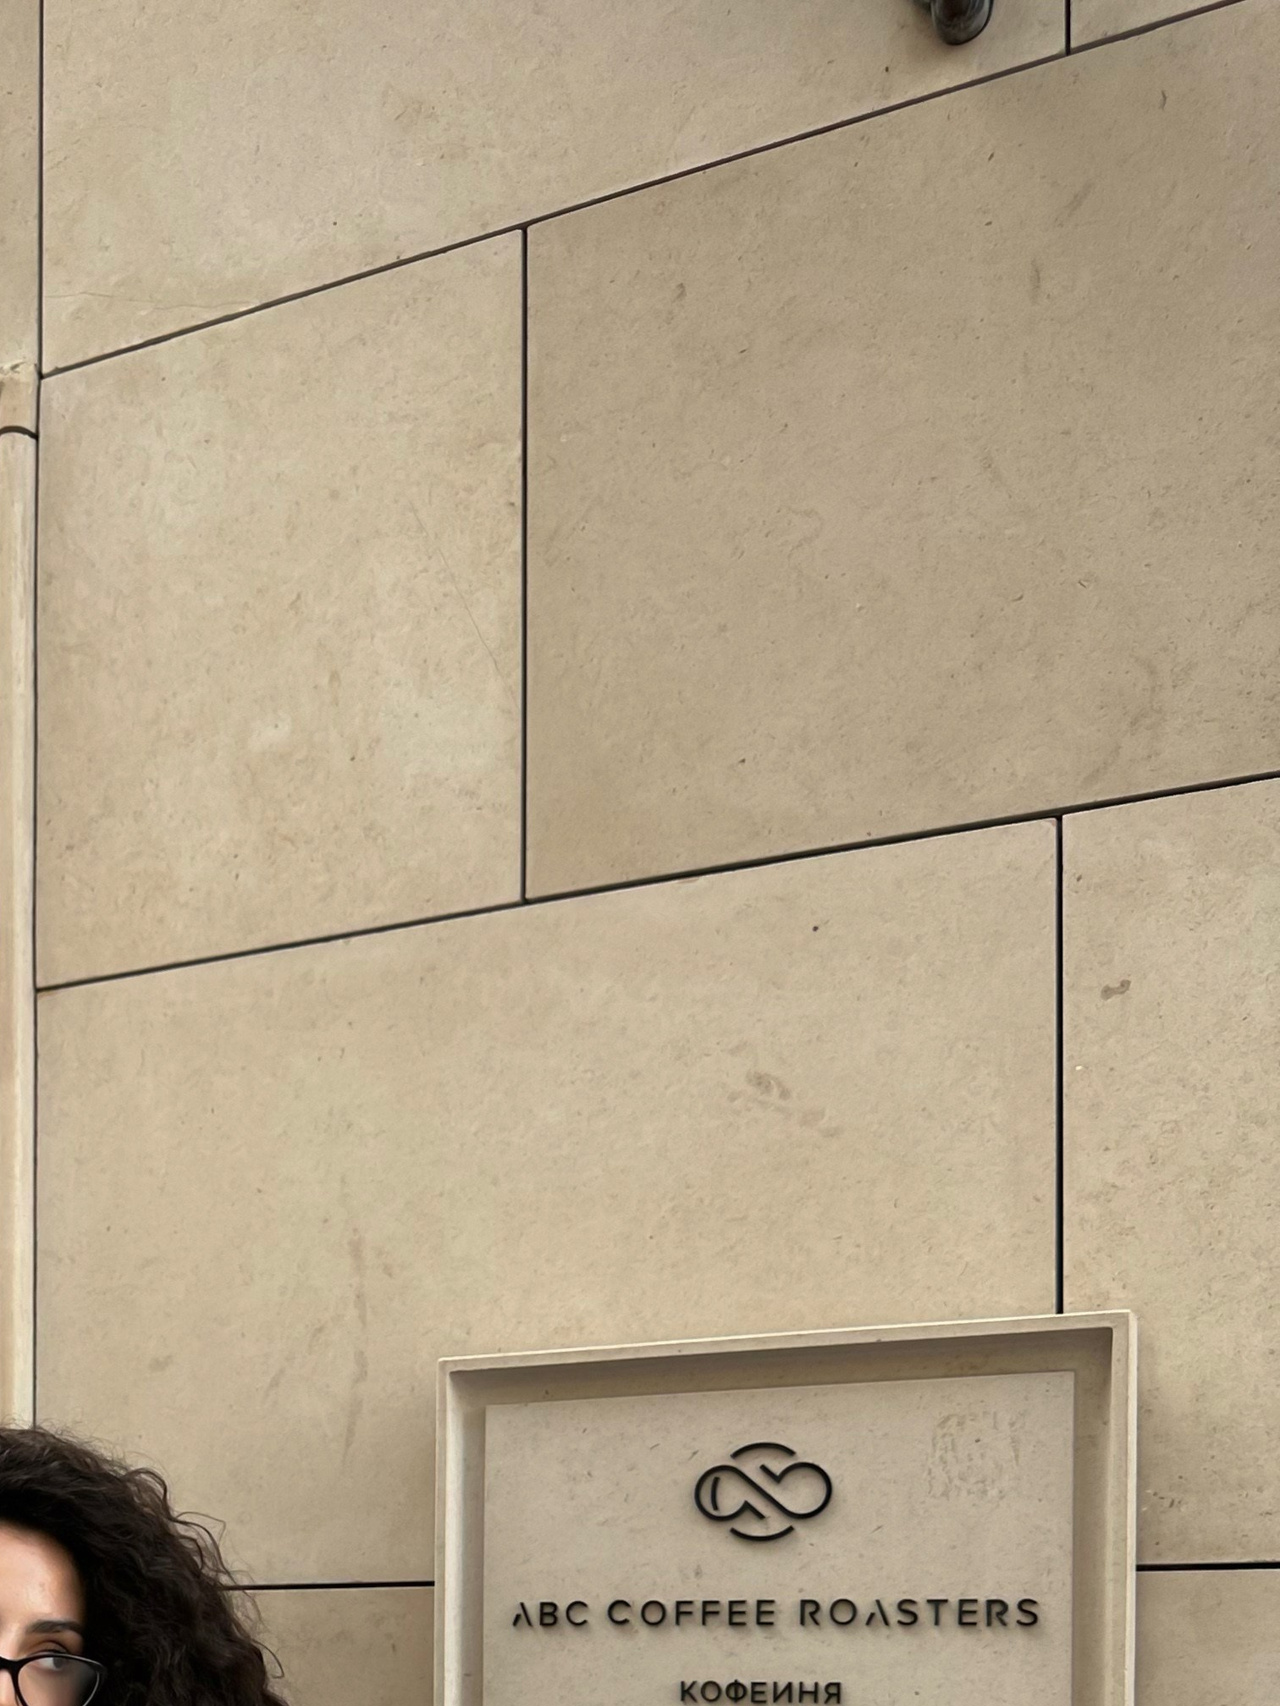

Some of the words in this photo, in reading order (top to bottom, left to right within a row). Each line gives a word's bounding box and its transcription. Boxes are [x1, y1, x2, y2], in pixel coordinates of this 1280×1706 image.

[512, 1600, 589, 1628] ABC
[606, 1599, 776, 1627] COFFEE
[799, 1598, 1039, 1628] ROASTERS
